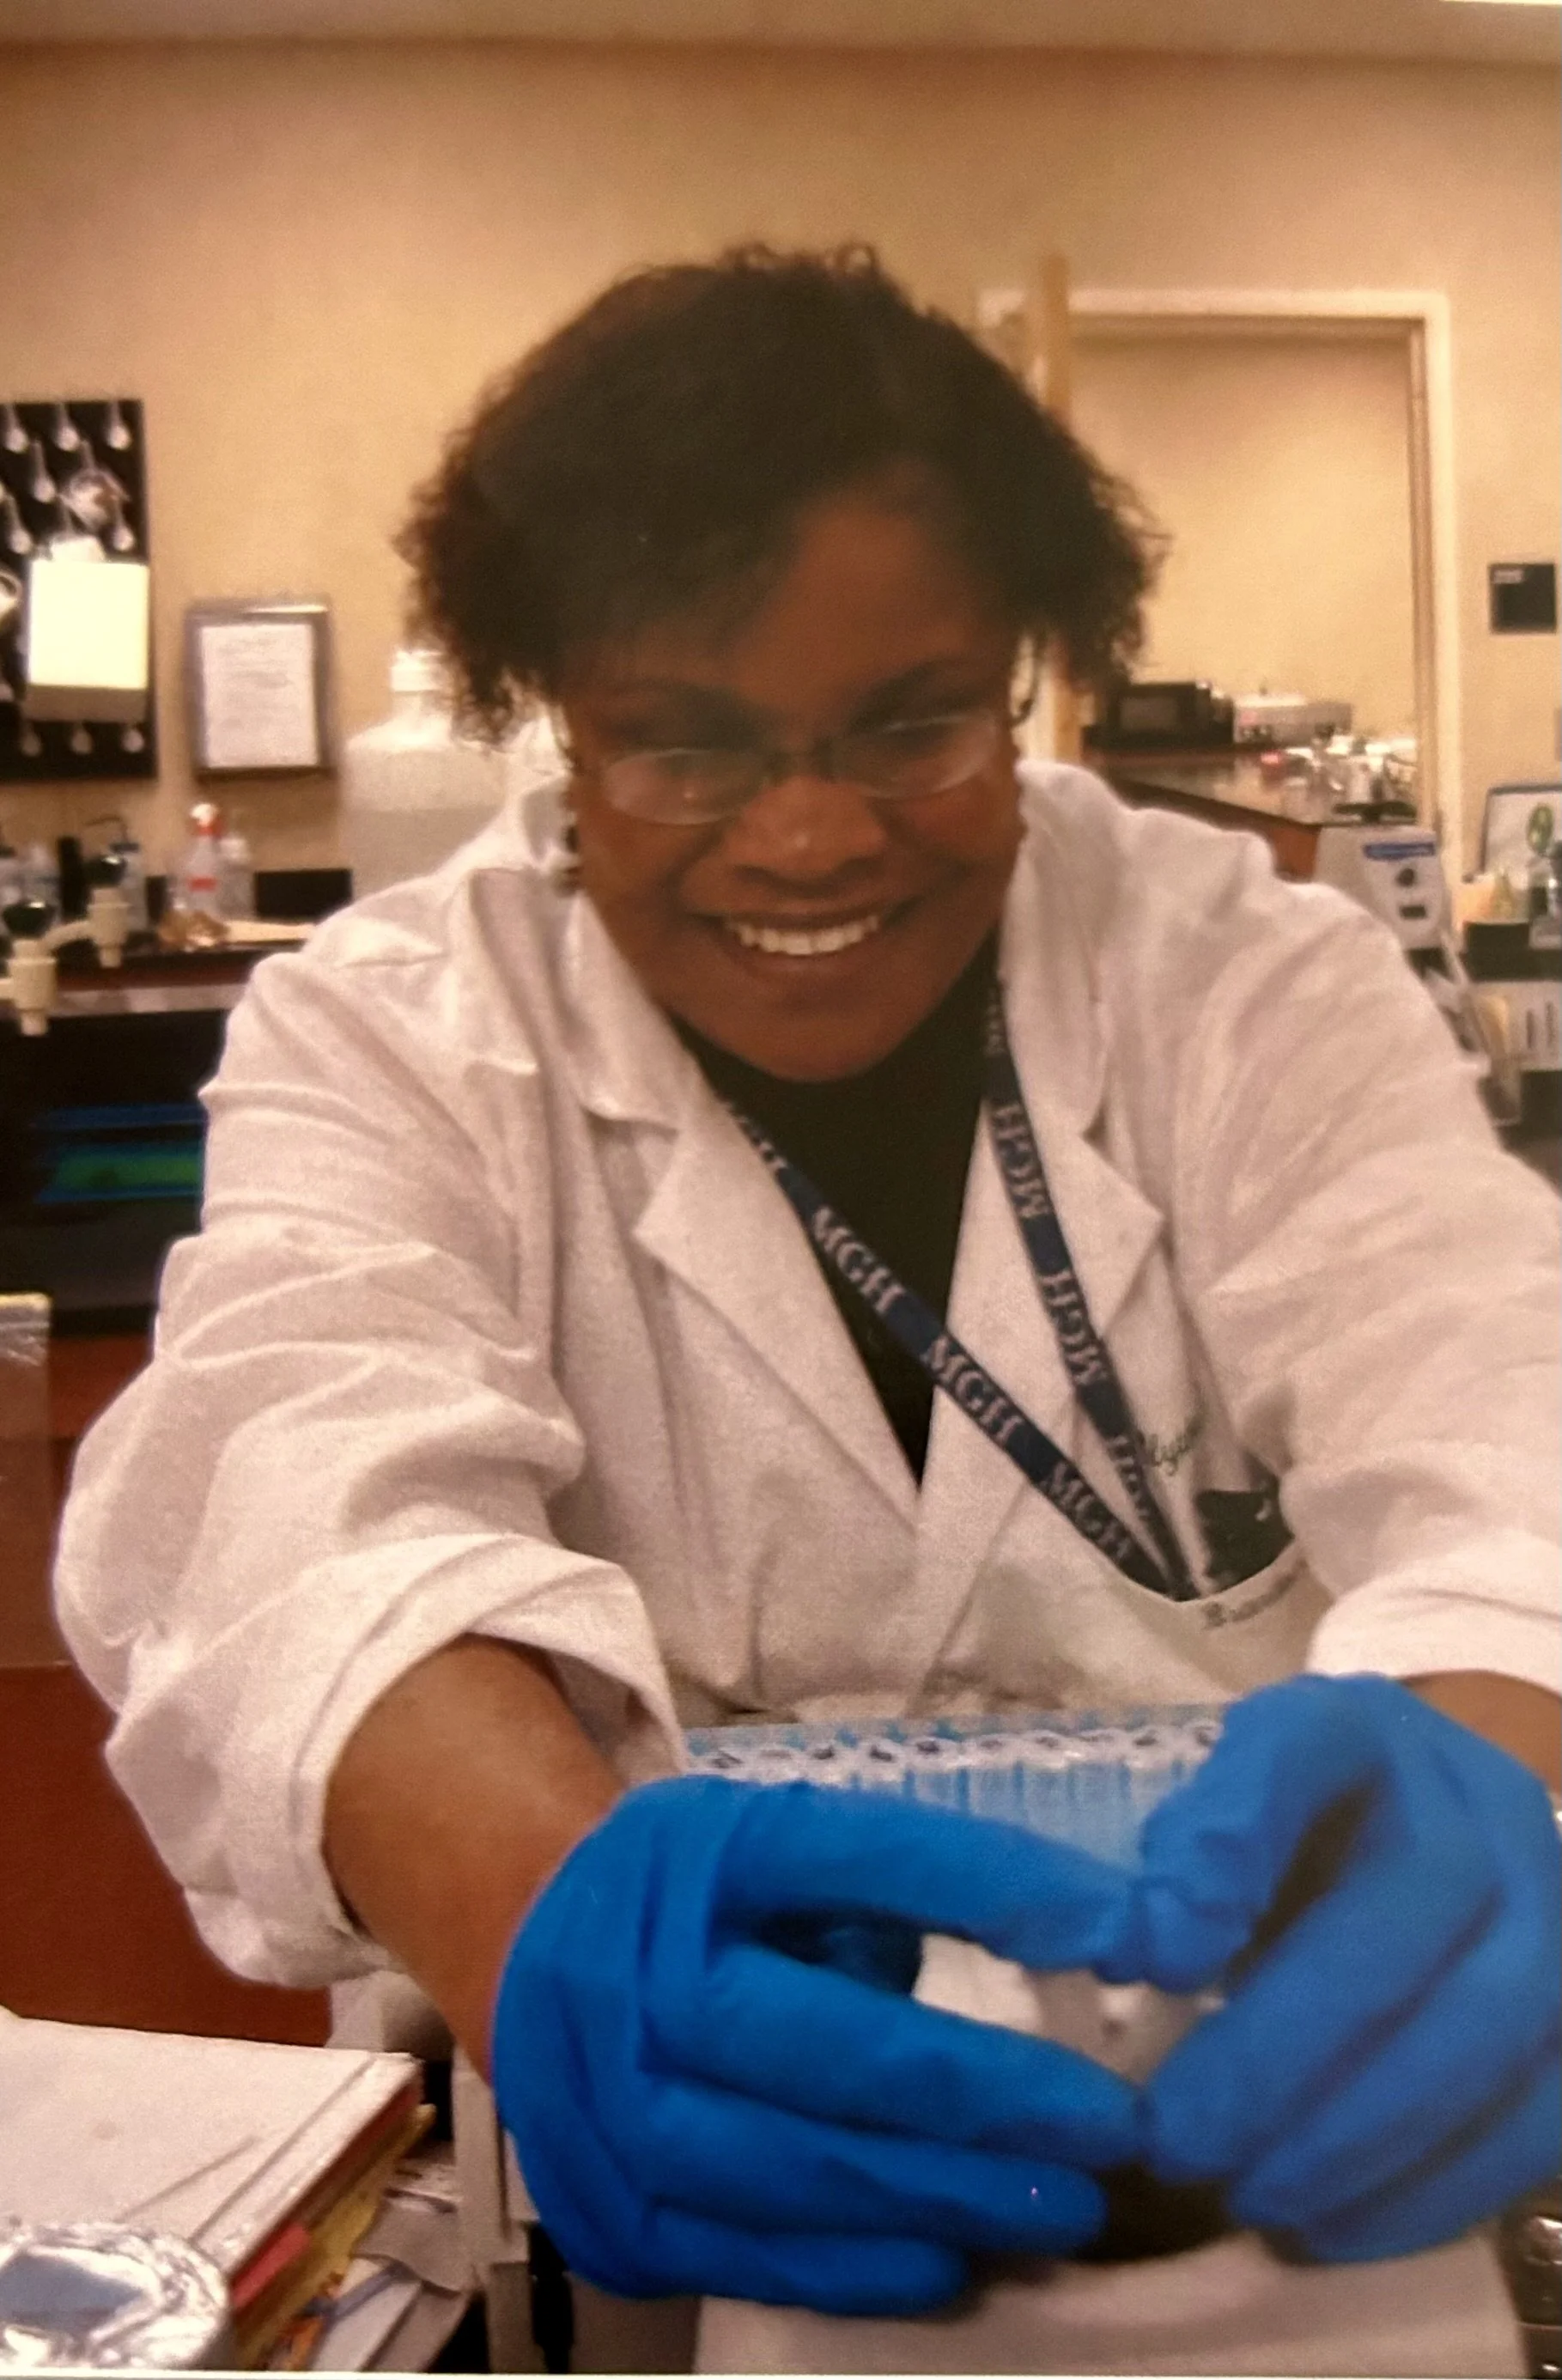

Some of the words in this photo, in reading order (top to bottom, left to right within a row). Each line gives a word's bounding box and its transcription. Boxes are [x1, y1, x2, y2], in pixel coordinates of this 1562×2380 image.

[992, 1103, 1049, 1220] MGH
[812, 1205, 906, 1314] MGH
[919, 1336, 1025, 1442] MGH
[1036, 1460, 1133, 1560] MGH
[1036, 1269, 1109, 1385] MGH
